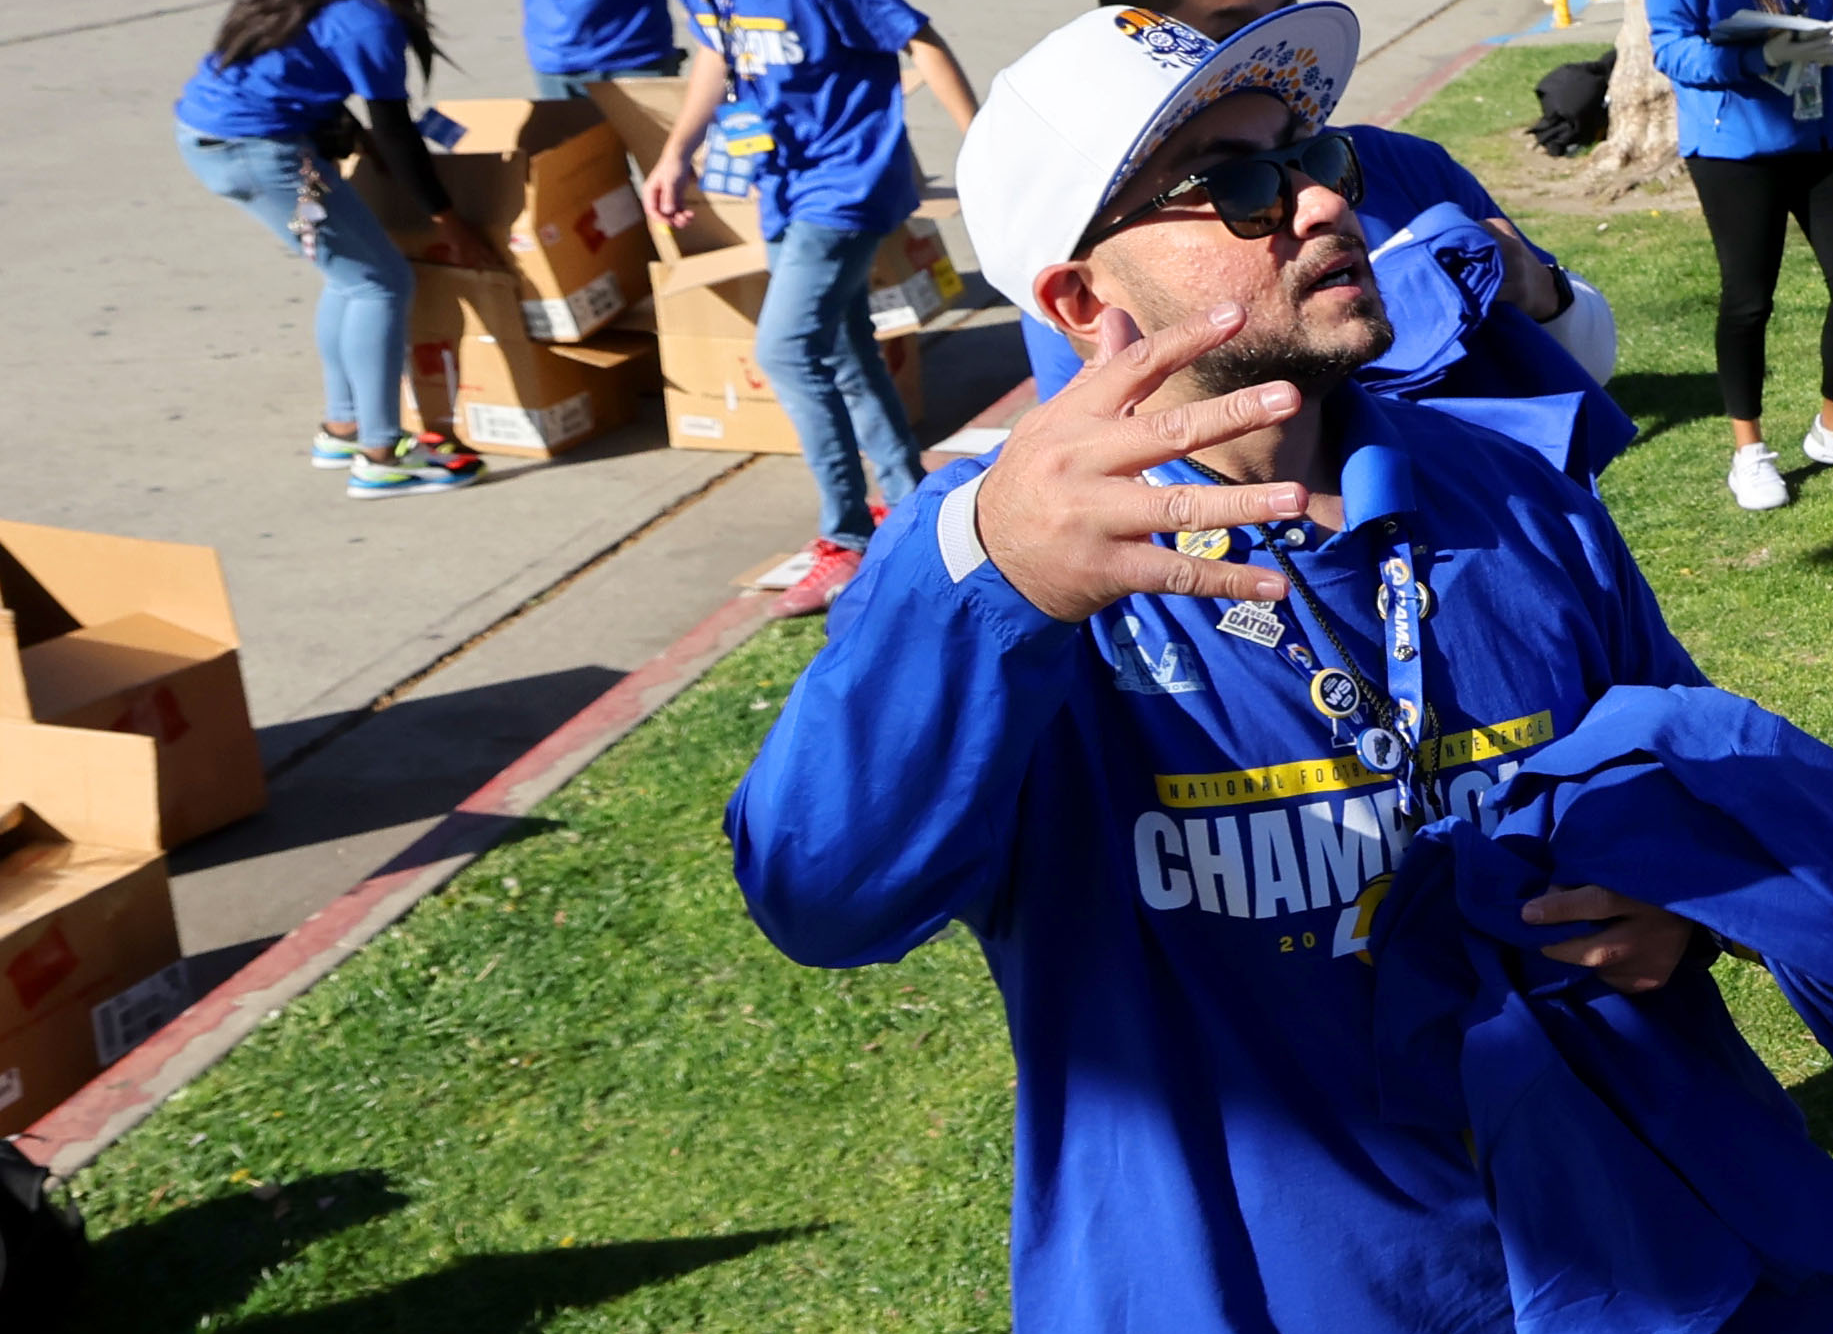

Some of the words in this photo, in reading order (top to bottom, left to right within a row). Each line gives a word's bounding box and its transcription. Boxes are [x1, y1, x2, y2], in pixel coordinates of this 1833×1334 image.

[1227, 610, 1281, 639] CATCH
[1325, 678, 1352, 706] WS
[1168, 773, 1286, 800] NATIONAL
[1442, 719, 1546, 758] NFERENCE
